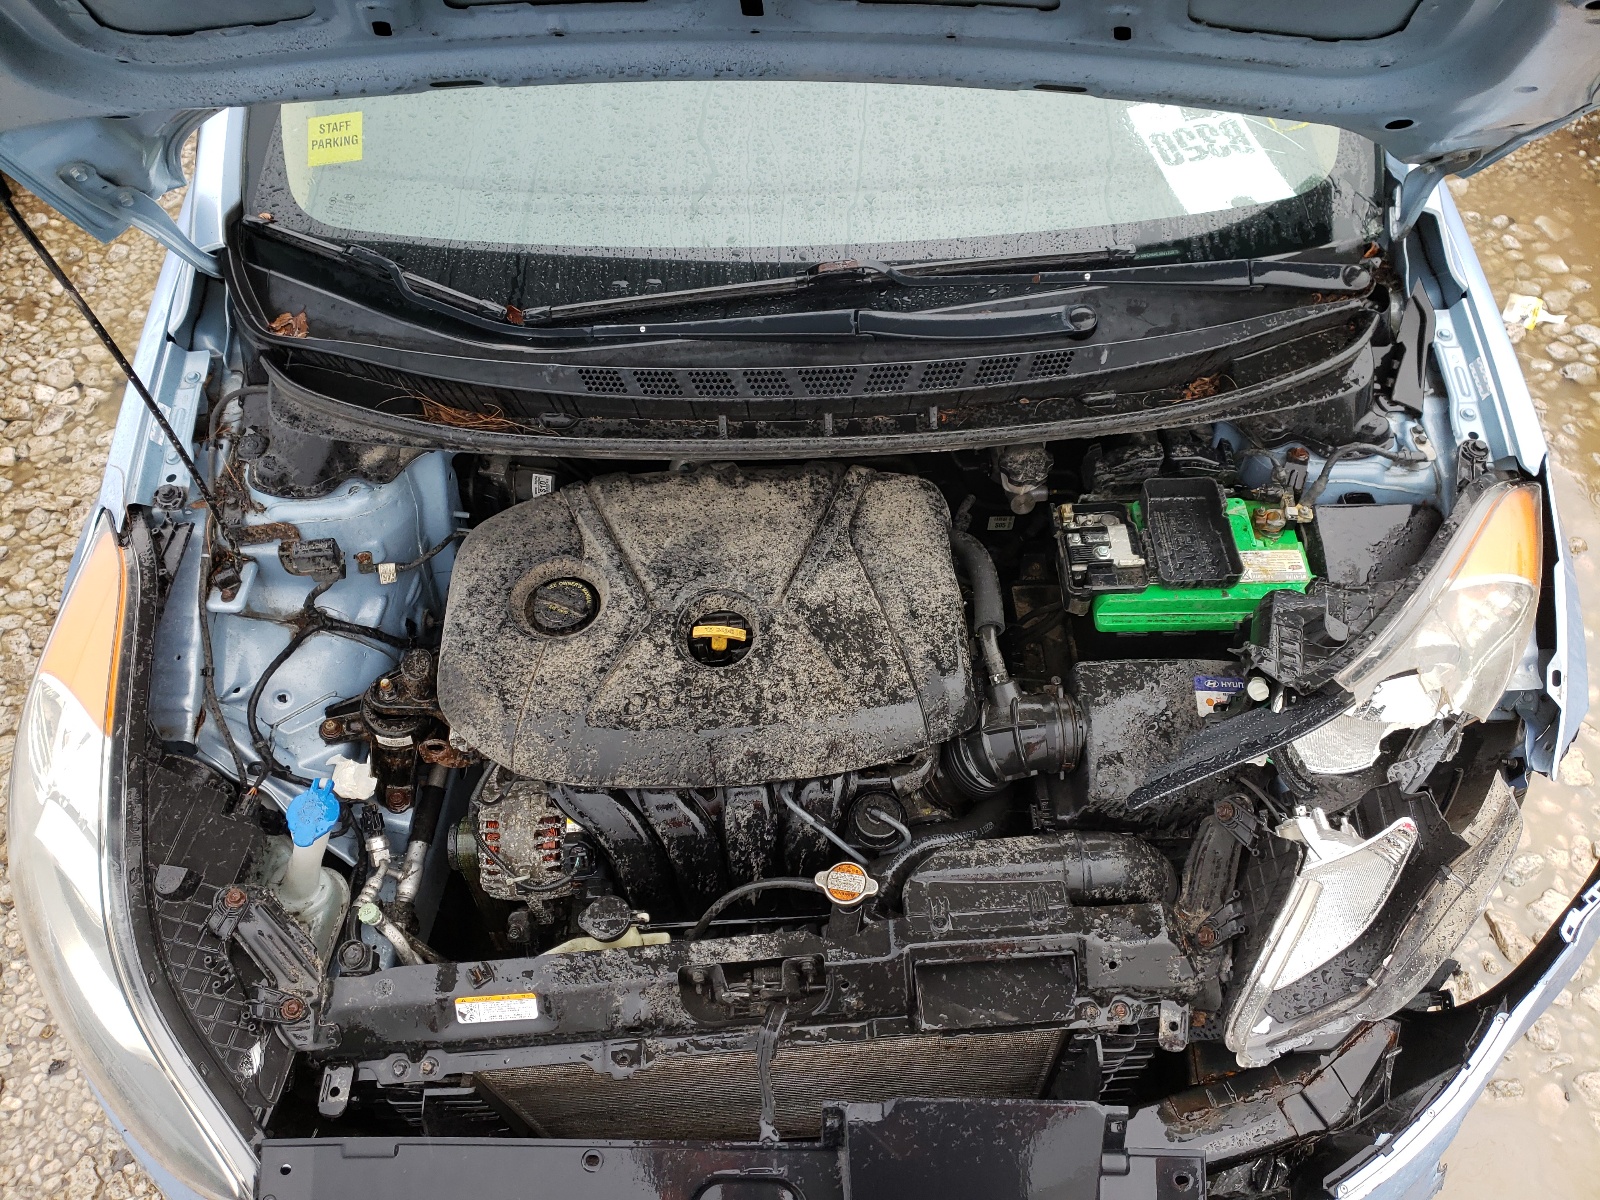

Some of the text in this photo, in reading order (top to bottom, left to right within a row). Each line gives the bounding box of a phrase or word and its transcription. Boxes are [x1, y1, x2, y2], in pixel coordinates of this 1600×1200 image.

[319, 120, 351, 134] STAFF
[311, 134, 359, 150] PARKING
[1220, 680, 1245, 689] HYUN
